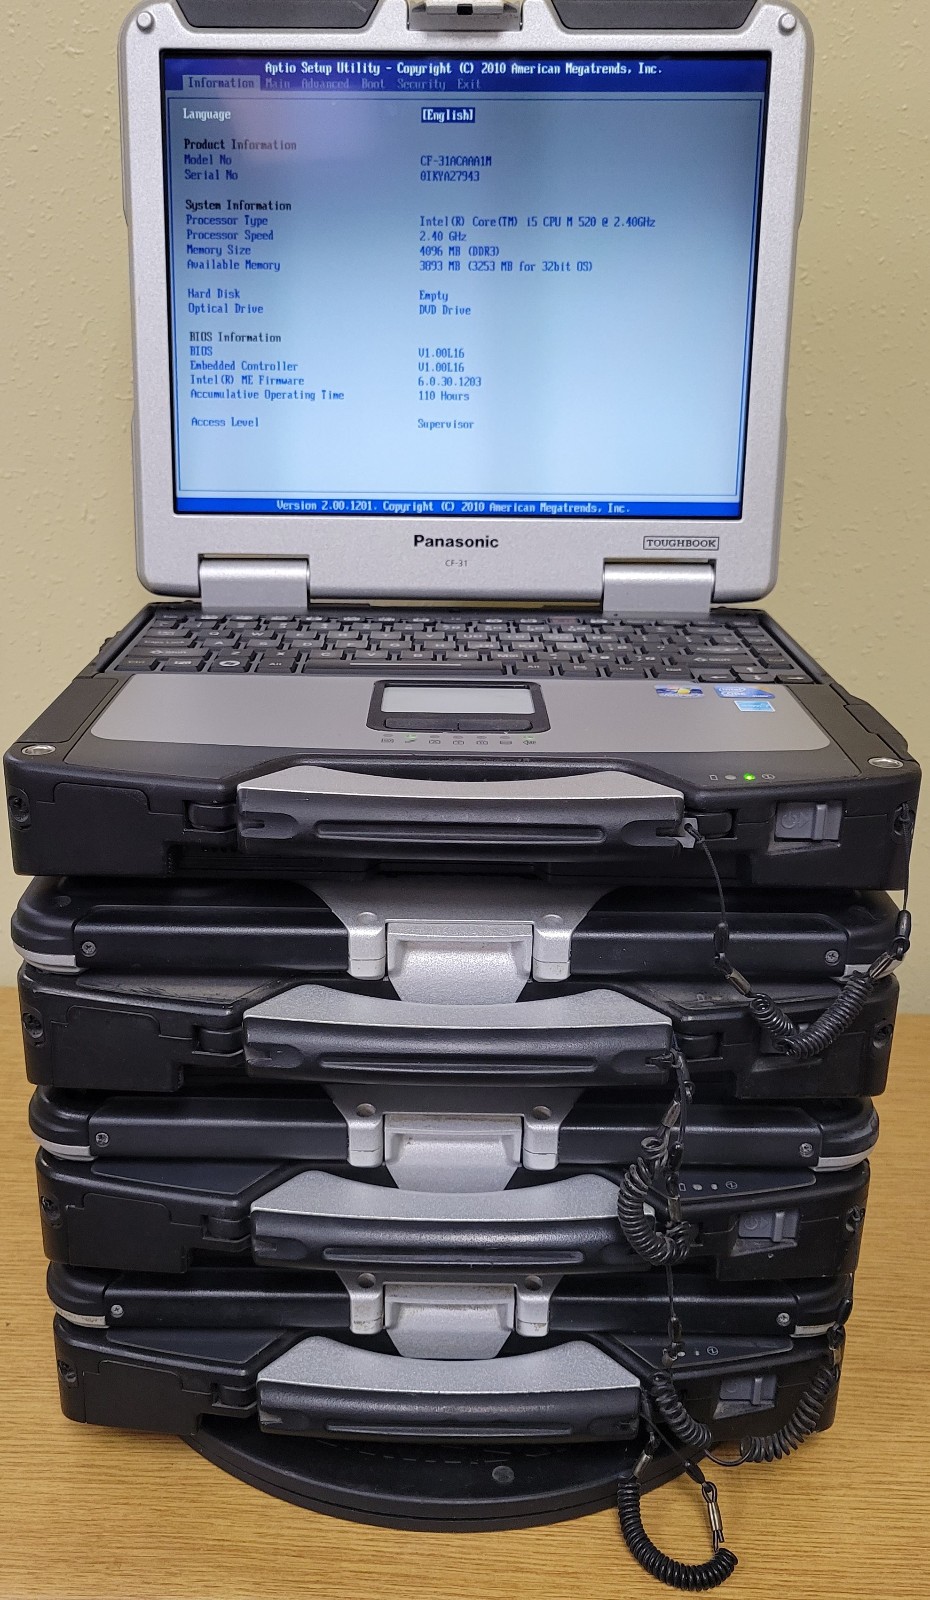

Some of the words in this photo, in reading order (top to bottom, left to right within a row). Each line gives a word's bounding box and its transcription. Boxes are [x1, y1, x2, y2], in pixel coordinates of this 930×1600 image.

[265, 62, 297, 75] Aptio
[301, 62, 332, 75] Setup
[337, 62, 381, 76] Utility
[396, 62, 452, 76] Copyright
[459, 62, 475, 75] (C)
[481, 62, 506, 74] 2010
[511, 62, 560, 75] American
[565, 62, 632, 76] Megatrends,
[638, 62, 662, 75] Inc.
[188, 77, 254, 89] Information
[265, 79, 290, 89] Main
[301, 79, 349, 90] Advanced
[361, 79, 385, 89] Boot
[397, 79, 446, 91] Security
[457, 79, 481, 90] Exit
[183, 108, 231, 121] Language
[422, 109, 474, 122] [English]
[184, 139, 226, 150] Product
[231, 140, 297, 151] Information
[184, 154, 213, 165] Model
[219, 154, 232, 165] No
[420, 155, 492, 167] CF-31ACAAA1M
[184, 169, 220, 181] Serial
[226, 169, 238, 181] No
[185, 200, 221, 213] System
[227, 201, 292, 211] Information
[186, 215, 239, 226] Processor
[245, 215, 268, 228] Type
[420, 216, 465, 228] Intel(R)
[472, 216, 518, 228] Core(TM)
[527, 216, 538, 228] i5
[543, 216, 561, 228] CPU
[566, 216, 573, 227] M
[578, 216, 597, 228] 520
[602, 217, 609, 228] @
[613, 216, 656, 228] 2.40GHz
[186, 230, 239, 241] Processor
[245, 230, 274, 243] Speed
[419, 231, 444, 242] 2.40
[449, 231, 467, 242] GHz
[186, 244, 222, 257] Memory
[227, 244, 251, 256] Size
[419, 246, 443, 257] 4096
[449, 246, 461, 257] MB
[468, 246, 500, 258] (DDR3)
[187, 260, 240, 270] Available
[245, 260, 281, 273] Memory
[419, 261, 443, 272] 3893
[449, 261, 461, 272] MB
[468, 261, 496, 273] (3253
[501, 261, 513, 273] MB
[519, 261, 536, 273] for
[541, 261, 571, 273] 32bit
[576, 261, 593, 273] OS)
[187, 288, 211, 299] Hard
[217, 288, 241, 299] Disk
[419, 290, 449, 302] Empty
[188, 303, 229, 315] Optical
[235, 303, 264, 314] Drive
[419, 305, 437, 316] DVD
[442, 305, 471, 316] Drive
[189, 332, 213, 343] BIOS
[218, 332, 282, 343] Information
[189, 346, 213, 357] BIOS
[418, 348, 465, 359] V1.00L16
[190, 361, 236, 371] Embedded
[241, 361, 298, 372] Controller
[418, 362, 465, 373] V1.00L16
[190, 375, 235, 386] Intel(R)
[241, 375, 254, 386] ME
[259, 375, 305, 386] Firmware
[418, 376, 482, 387] 6.0.30.1203
[190, 389, 260, 400] Accumulative
[264, 389, 316, 401] Operating
[321, 390, 345, 400] Time
[418, 391, 436, 401] 110
[440, 391, 470, 401] Hours
[191, 417, 226, 427] Access
[231, 417, 260, 428] Level
[417, 419, 474, 431] Supervisor
[276, 500, 317, 511] Version
[383, 501, 434, 514] Copyright
[441, 502, 455, 513] (C)
[461, 502, 485, 513] 2010
[489, 502, 535, 513] American
[540, 503, 603, 515] Megatrends,
[607, 503, 630, 514] Inc.
[413, 534, 499, 549] Panasonic
[646, 538, 716, 548] TOUGHBOOK
[445, 559, 468, 567] CF-31
